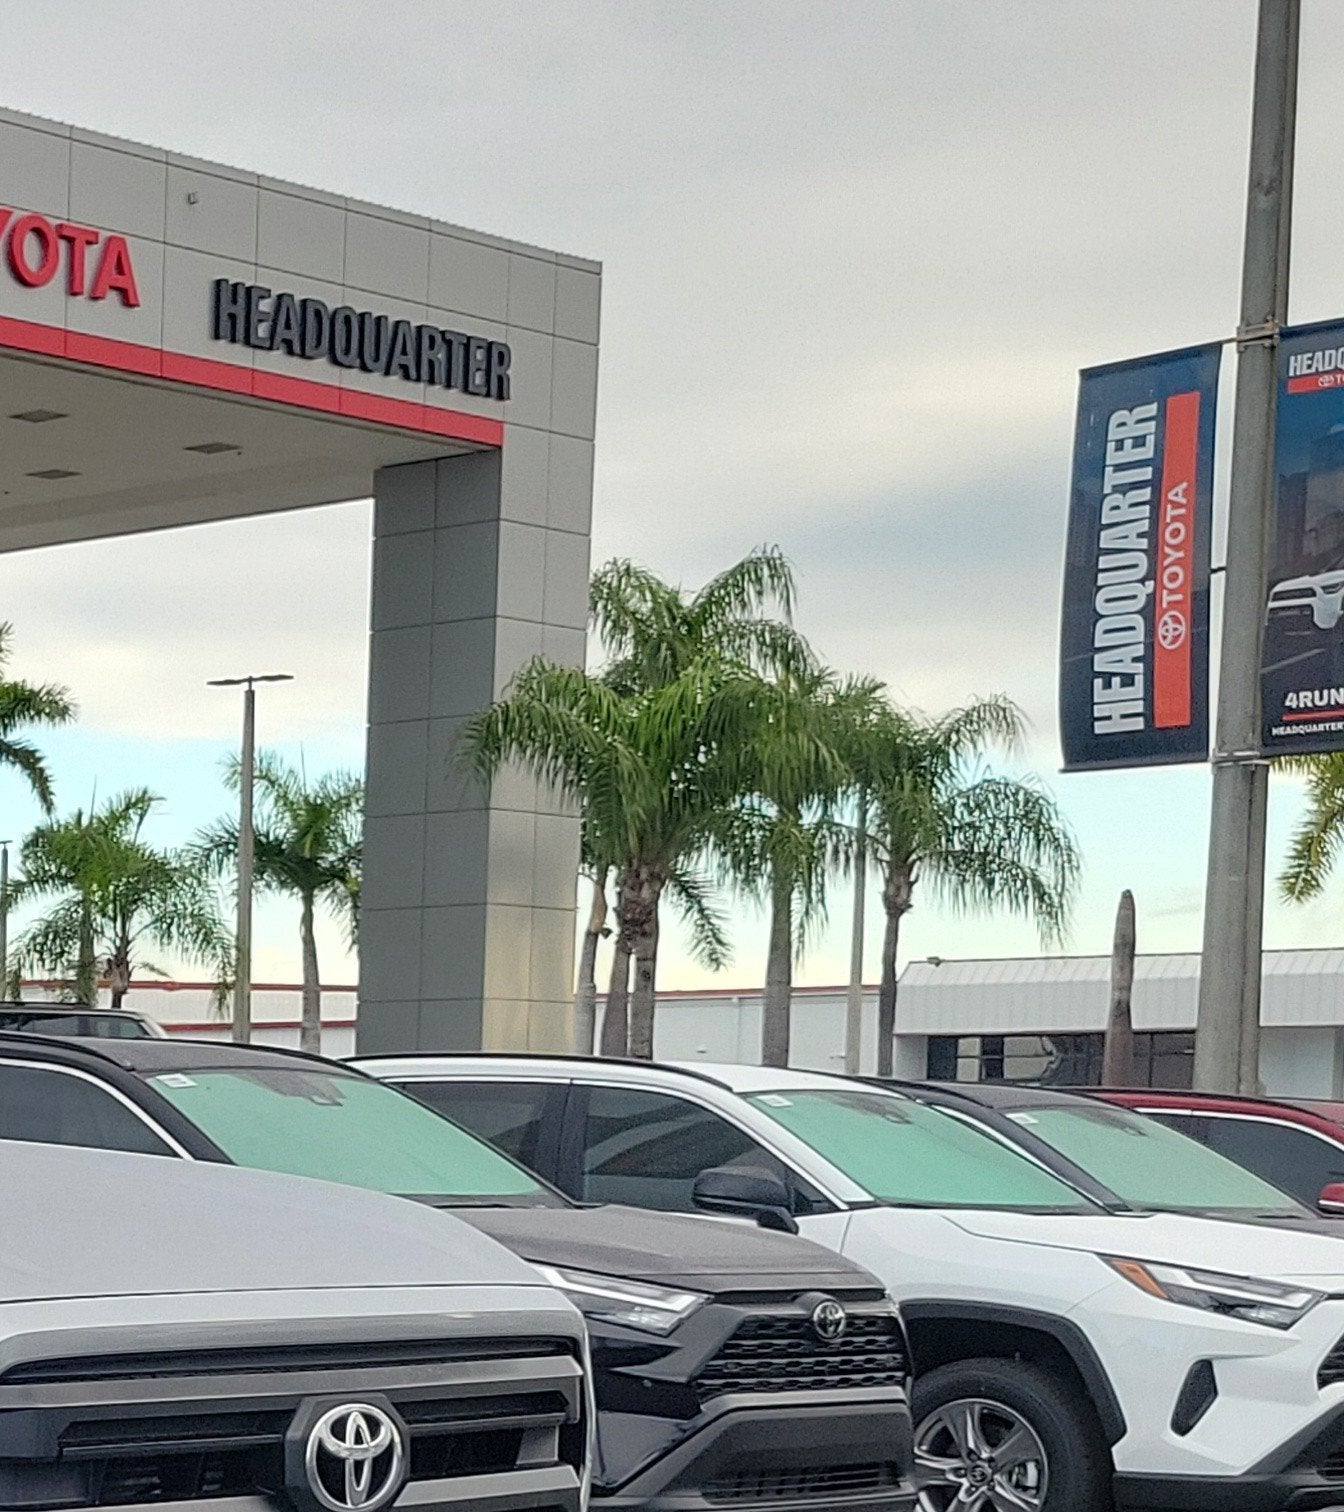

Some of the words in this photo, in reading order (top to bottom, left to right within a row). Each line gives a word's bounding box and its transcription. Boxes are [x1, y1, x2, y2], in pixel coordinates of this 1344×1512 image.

[212, 278, 511, 400] HEADQUARTER
[1092, 401, 1158, 735] HEADQUARTER
[1161, 482, 1188, 607] TOYOTA
